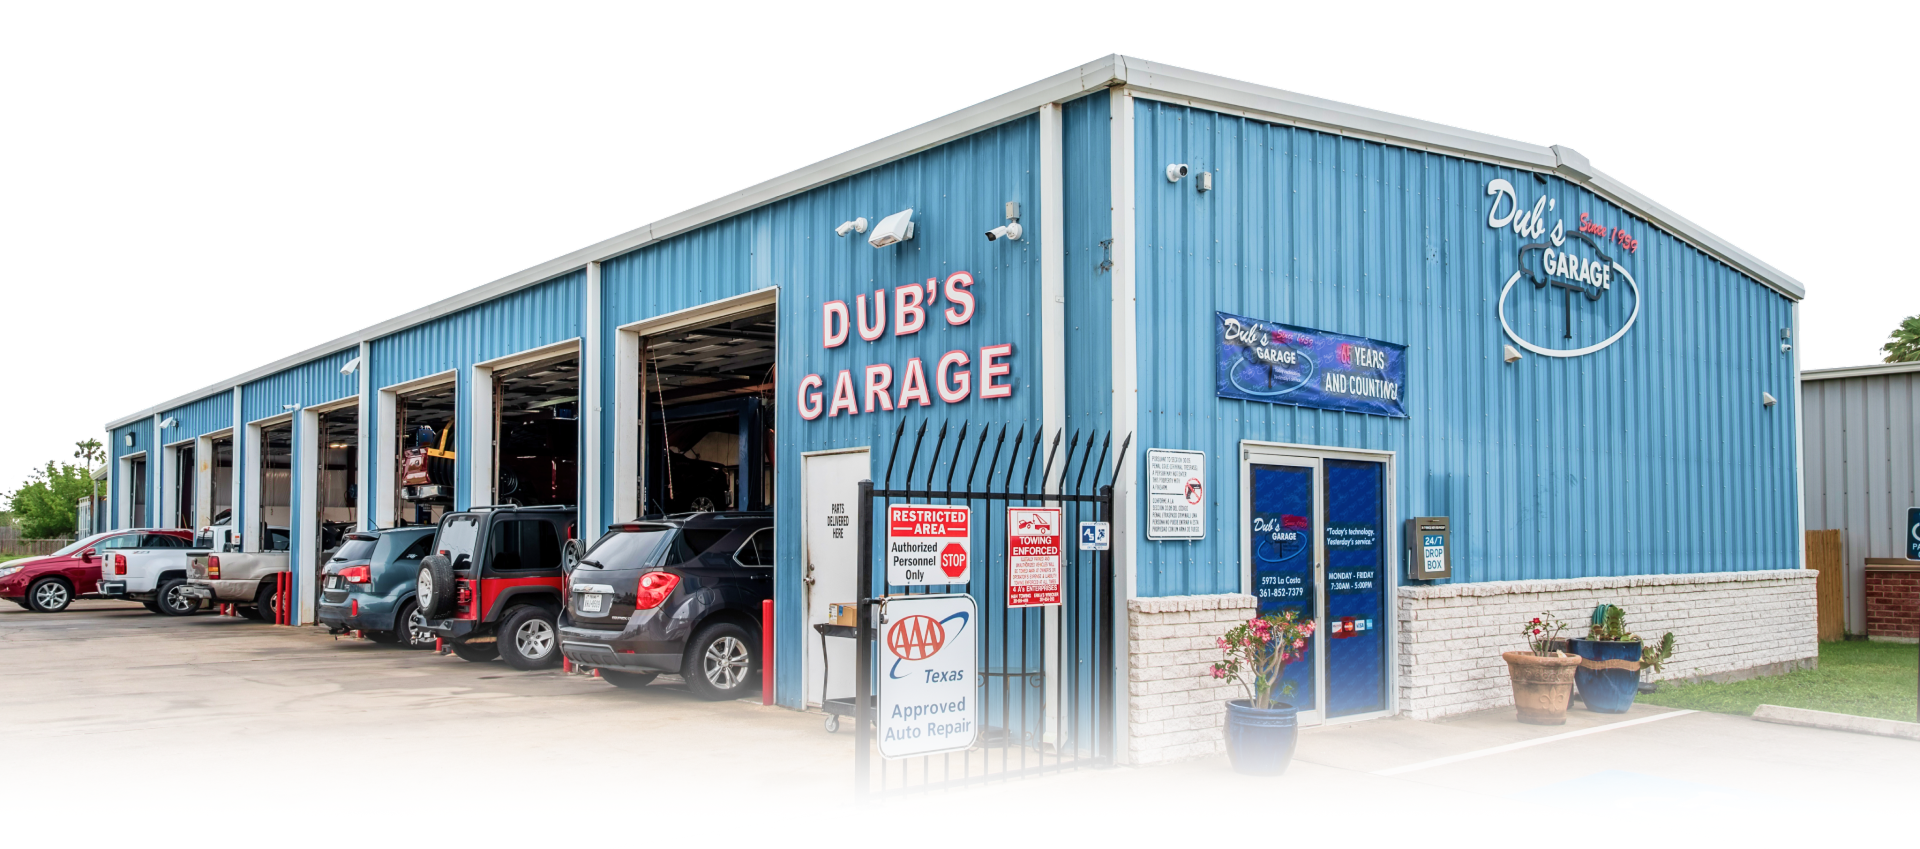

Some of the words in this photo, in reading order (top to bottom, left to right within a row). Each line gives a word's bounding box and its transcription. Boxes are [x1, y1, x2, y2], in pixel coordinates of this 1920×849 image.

[1487, 178, 1566, 247] Dub's
[1579, 212, 1607, 238] Since
[1611, 226, 1639, 254] 1959
[1543, 248, 1610, 290] GARAGE
[822, 270, 976, 349] DUB'S
[1224, 318, 1269, 347] Dub's
[1256, 347, 1296, 365] GARAGE
[1354, 346, 1385, 370] YEARS
[798, 343, 1012, 421] GARAGE
[1325, 372, 1347, 394] AND
[831, 503, 845, 514] PARTS
[893, 510, 966, 523] RESTRICTED
[914, 523, 946, 535] AREA
[1254, 517, 1281, 532] Dub's
[832, 528, 844, 539] HERE
[1272, 532, 1297, 541] GARAGE
[1019, 536, 1052, 545] TOWING
[1424, 536, 1442, 546] 24/7
[891, 542, 938, 553] Authorized
[1012, 546, 1058, 556] ENFORCED
[1425, 548, 1443, 558] DROP
[893, 555, 936, 567] Personnel
[942, 553, 966, 567] STOP
[1427, 560, 1442, 569] BOX
[905, 569, 924, 582] Only
[1261, 577, 1277, 585] 5973
[1278, 576, 1284, 584] La
[1286, 576, 1301, 585] Costa
[1328, 572, 1353, 580] MONDAY
[1356, 571, 1374, 579] FRIDAY
[1259, 587, 1304, 598] 361-852-7379
[894, 615, 941, 661] AAA
[925, 669, 964, 684] Texas
[891, 696, 966, 722] Approved
[884, 727, 921, 742] Auto
[927, 718, 971, 739] Repair
